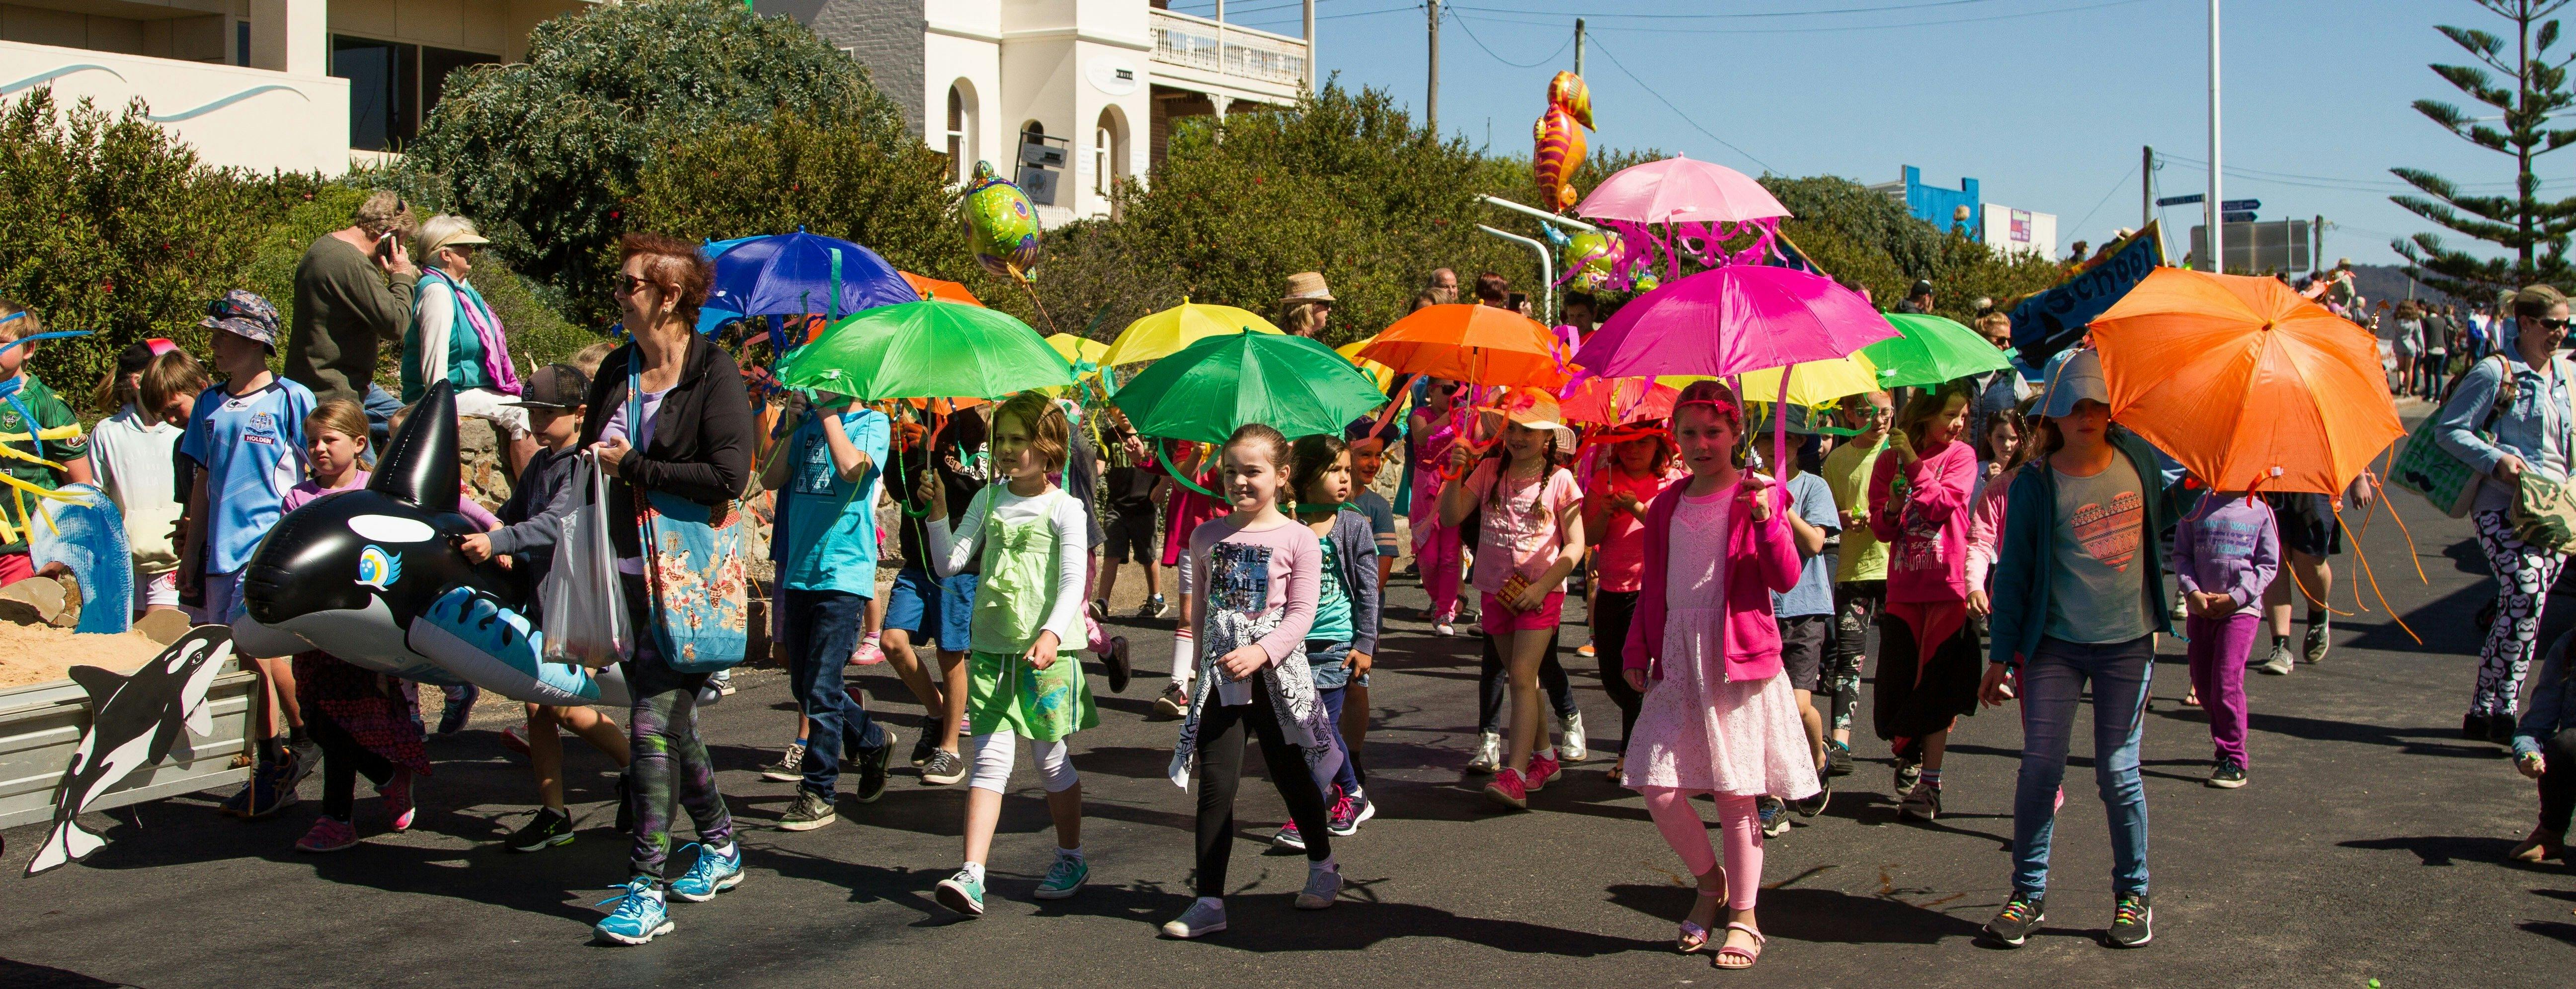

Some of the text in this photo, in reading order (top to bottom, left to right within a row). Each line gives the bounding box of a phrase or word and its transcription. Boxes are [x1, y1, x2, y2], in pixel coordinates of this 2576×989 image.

[2043, 240, 2153, 314] School
[246, 435, 272, 444] HOLDEN
[2230, 521, 2257, 534] WAIT
[1911, 540, 1944, 550] PEACEFL
[1909, 554, 1943, 571] WARRIOR
